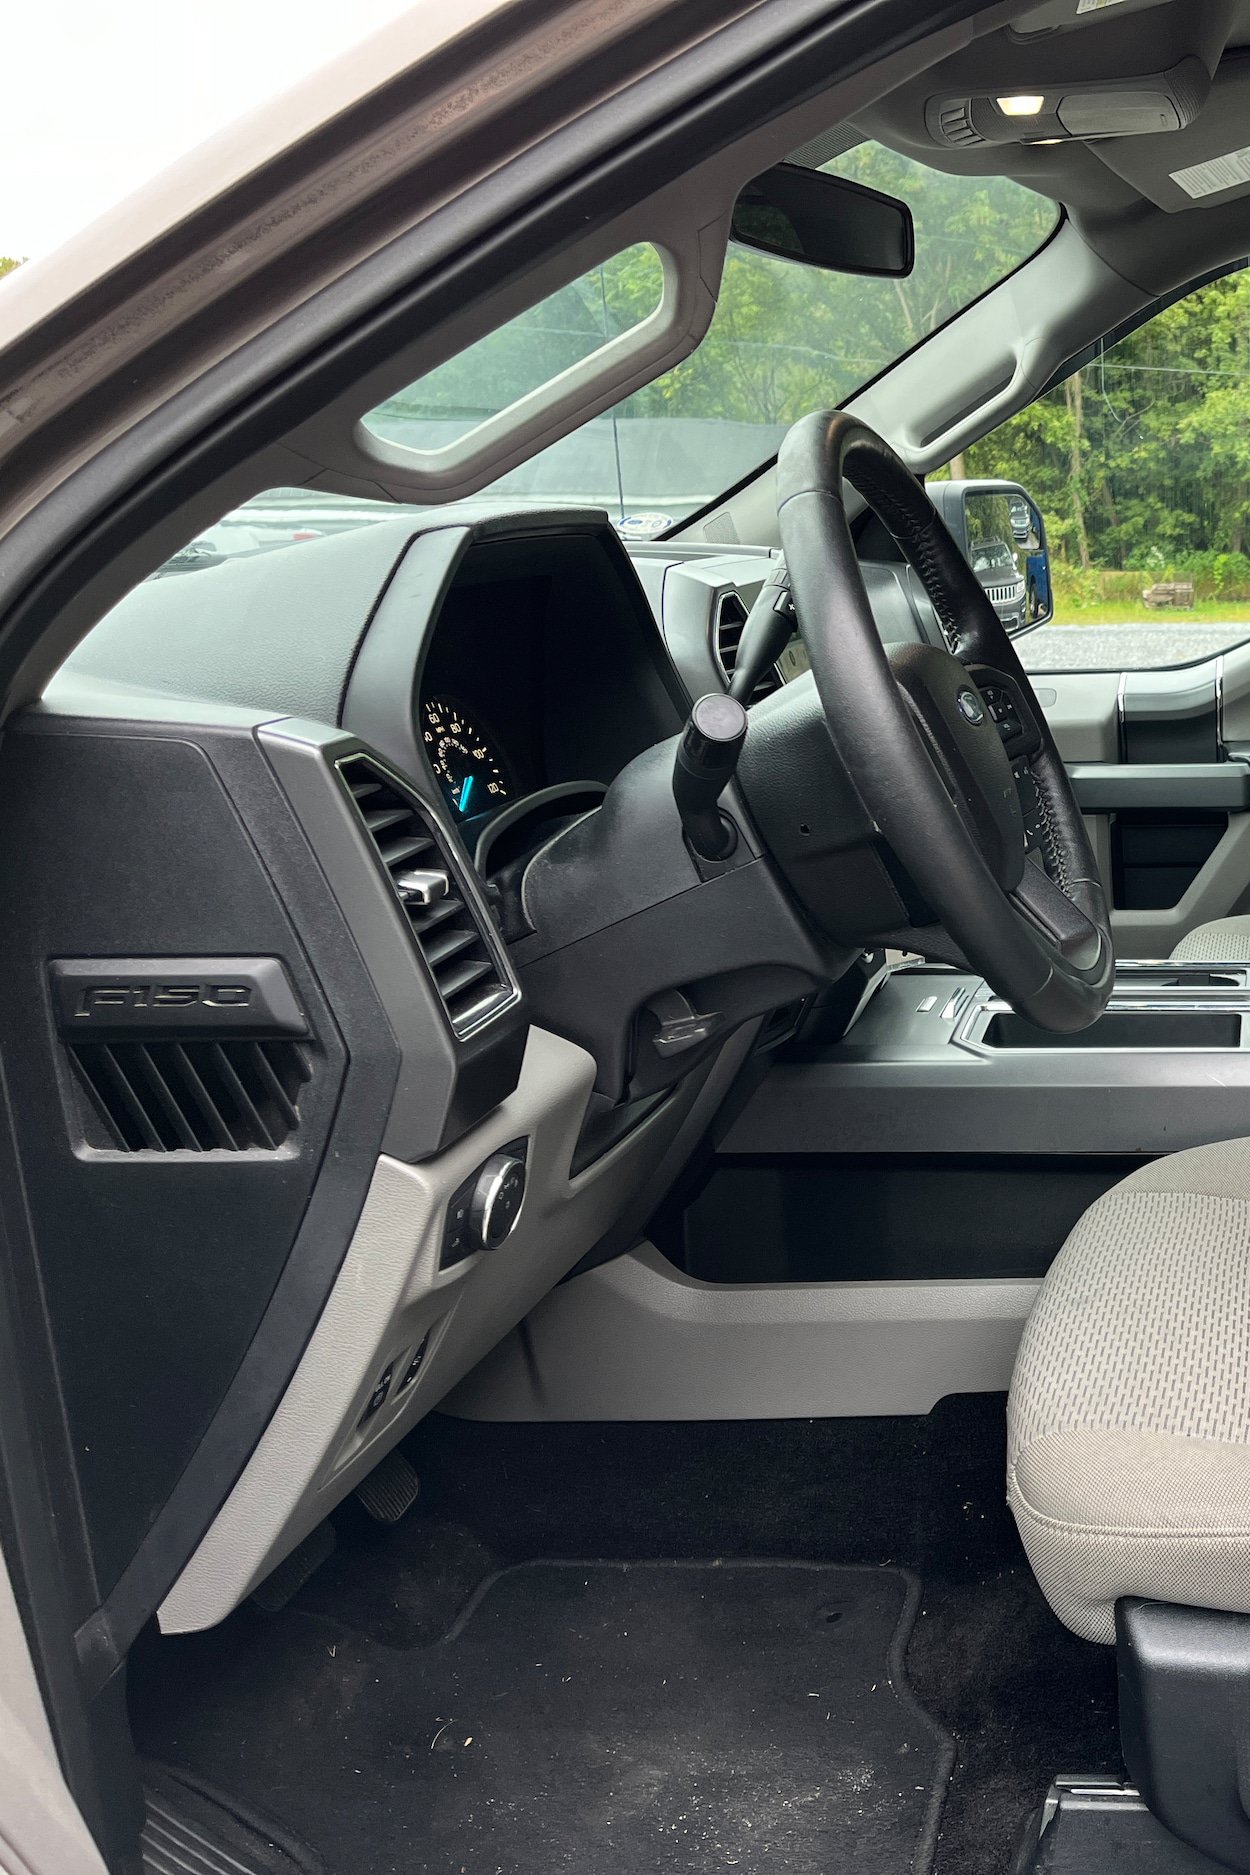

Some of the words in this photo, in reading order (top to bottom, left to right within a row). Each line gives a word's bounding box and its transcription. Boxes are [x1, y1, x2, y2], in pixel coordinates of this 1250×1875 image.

[428, 713, 440, 724] 60
[450, 723, 461, 733] 80
[74, 984, 252, 1018] F150
